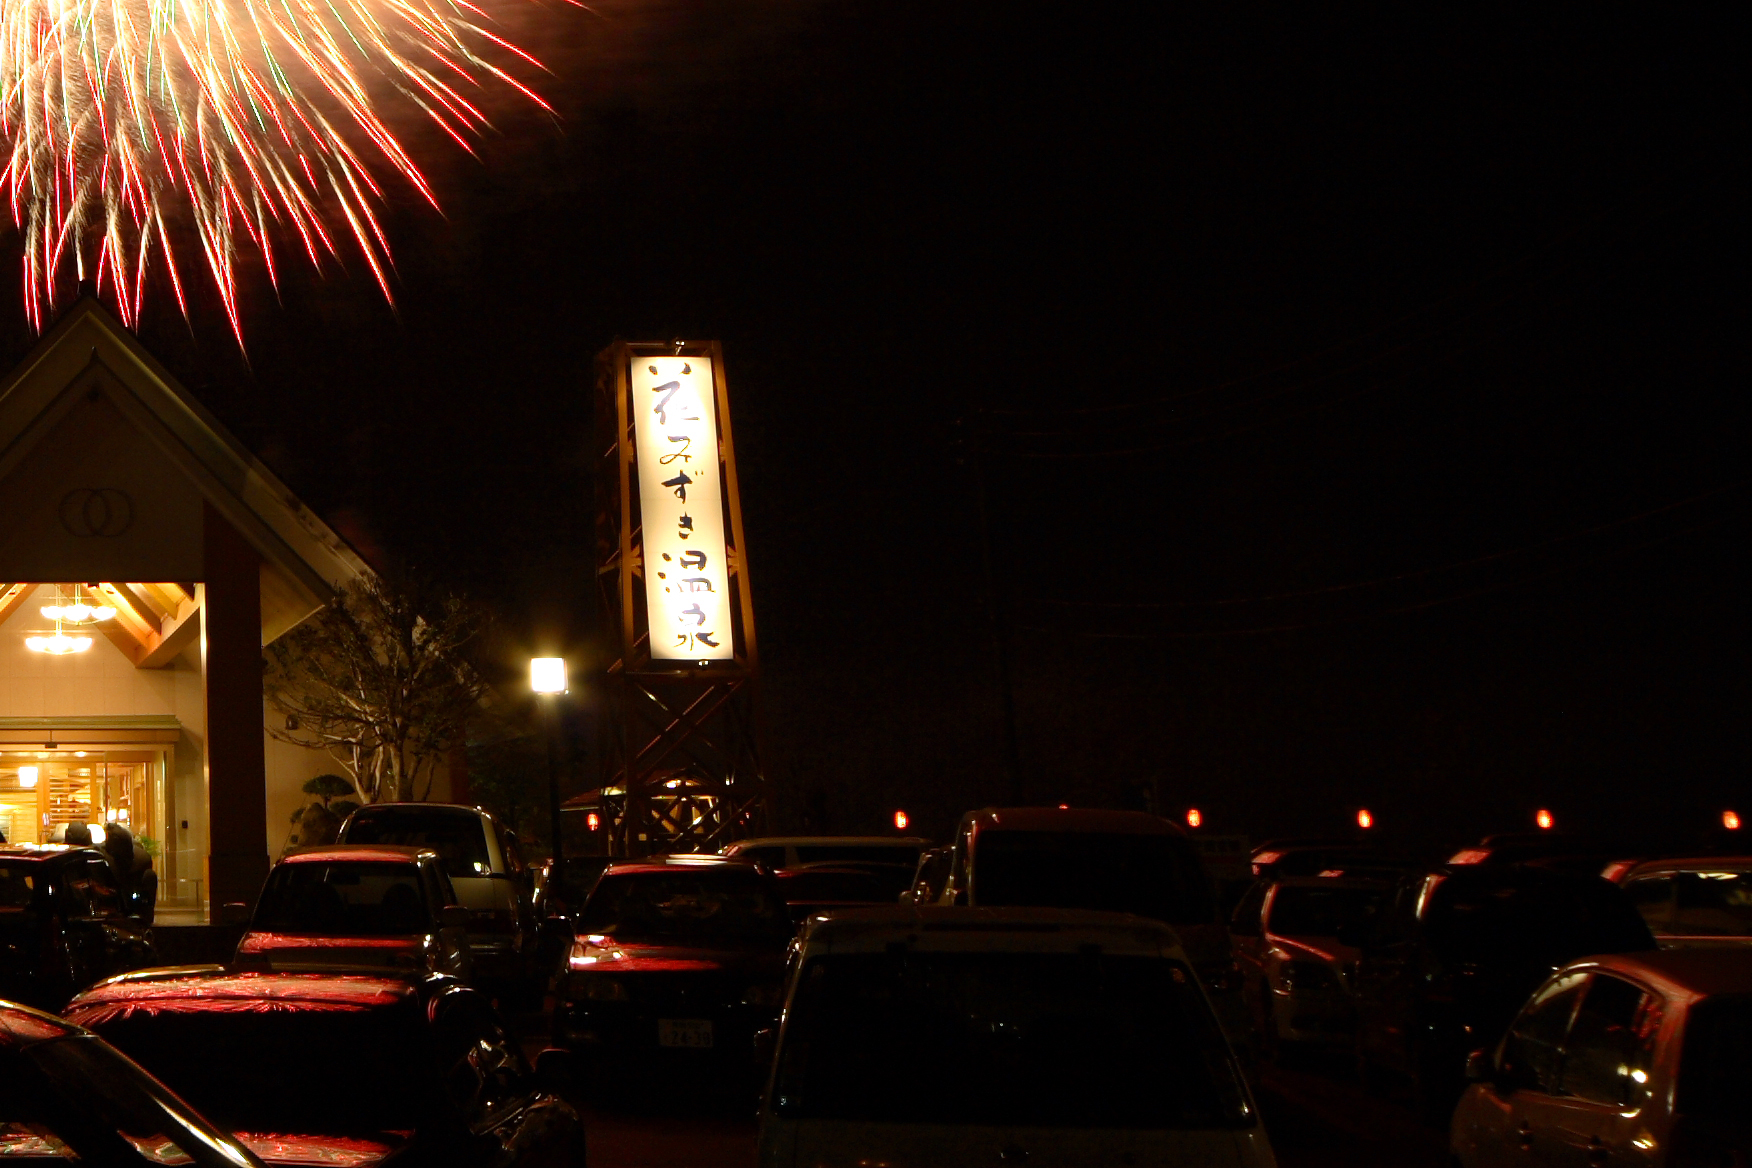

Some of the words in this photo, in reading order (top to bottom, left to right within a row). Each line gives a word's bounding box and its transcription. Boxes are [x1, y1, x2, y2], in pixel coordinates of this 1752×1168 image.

[648, 362, 721, 651] 花みずき温泉
